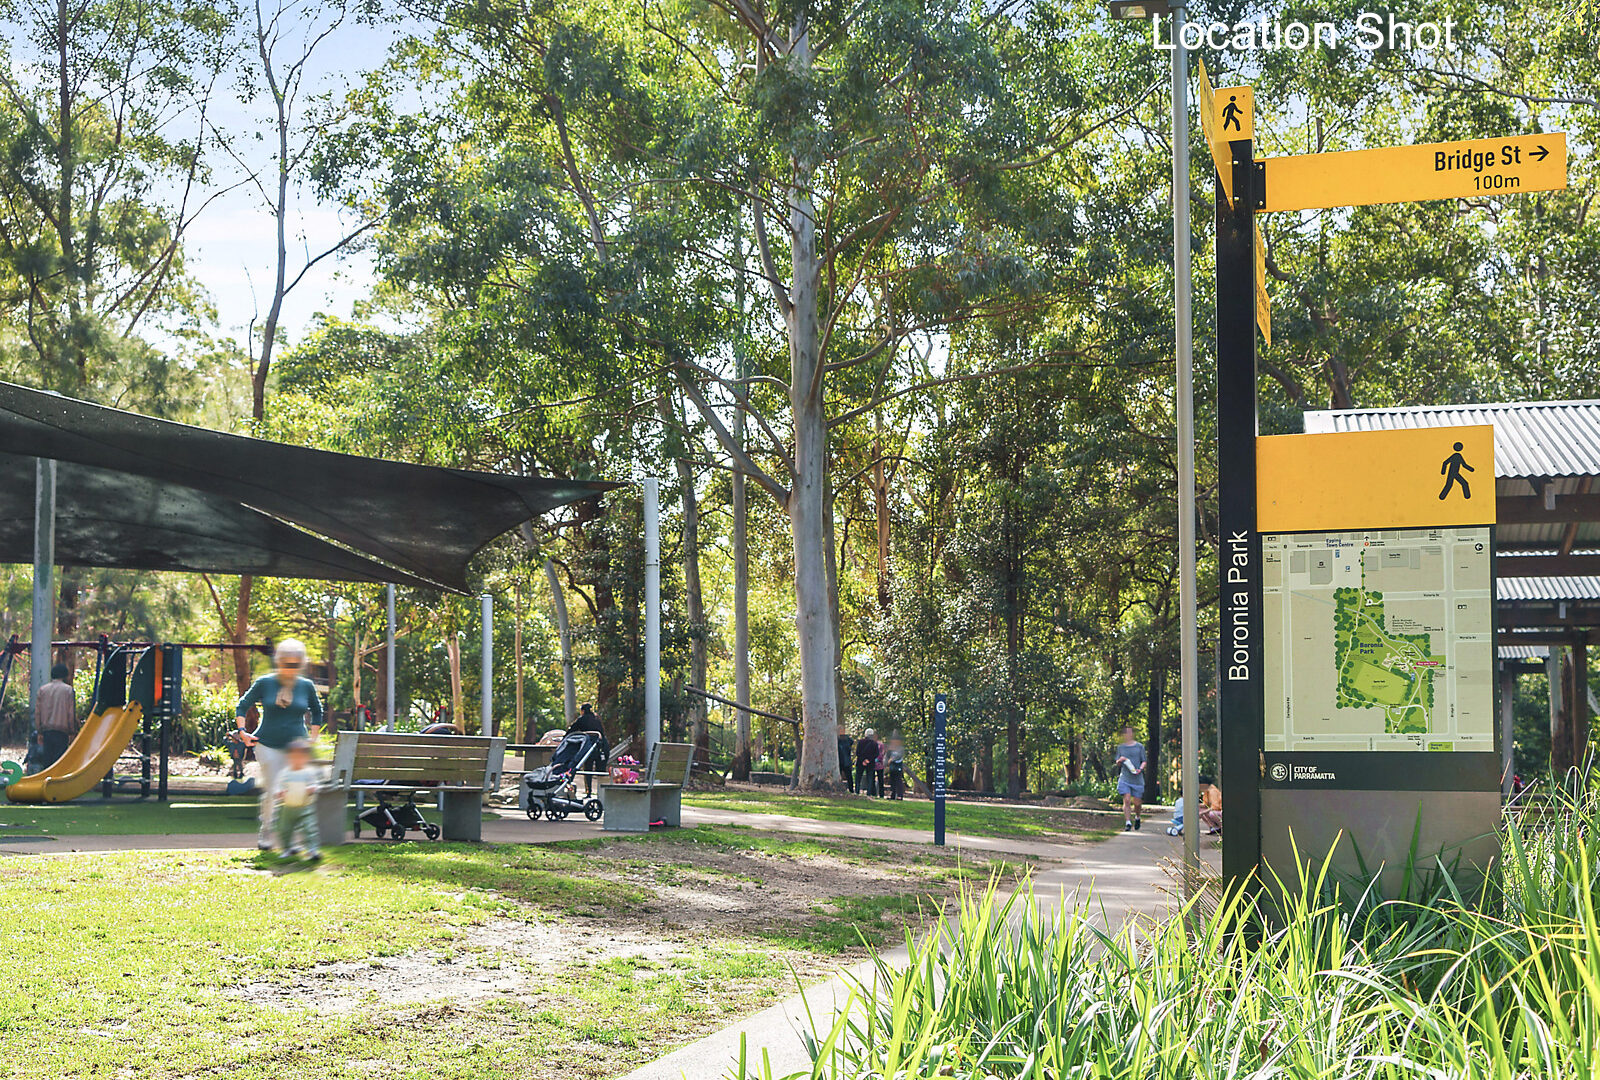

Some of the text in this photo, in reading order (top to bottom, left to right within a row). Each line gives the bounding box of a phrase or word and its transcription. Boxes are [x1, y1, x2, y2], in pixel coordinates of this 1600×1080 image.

[1434, 145, 1522, 173] Bridge St
[1473, 174, 1520, 190] 100m
[1227, 529, 1250, 681] Boronia Park
